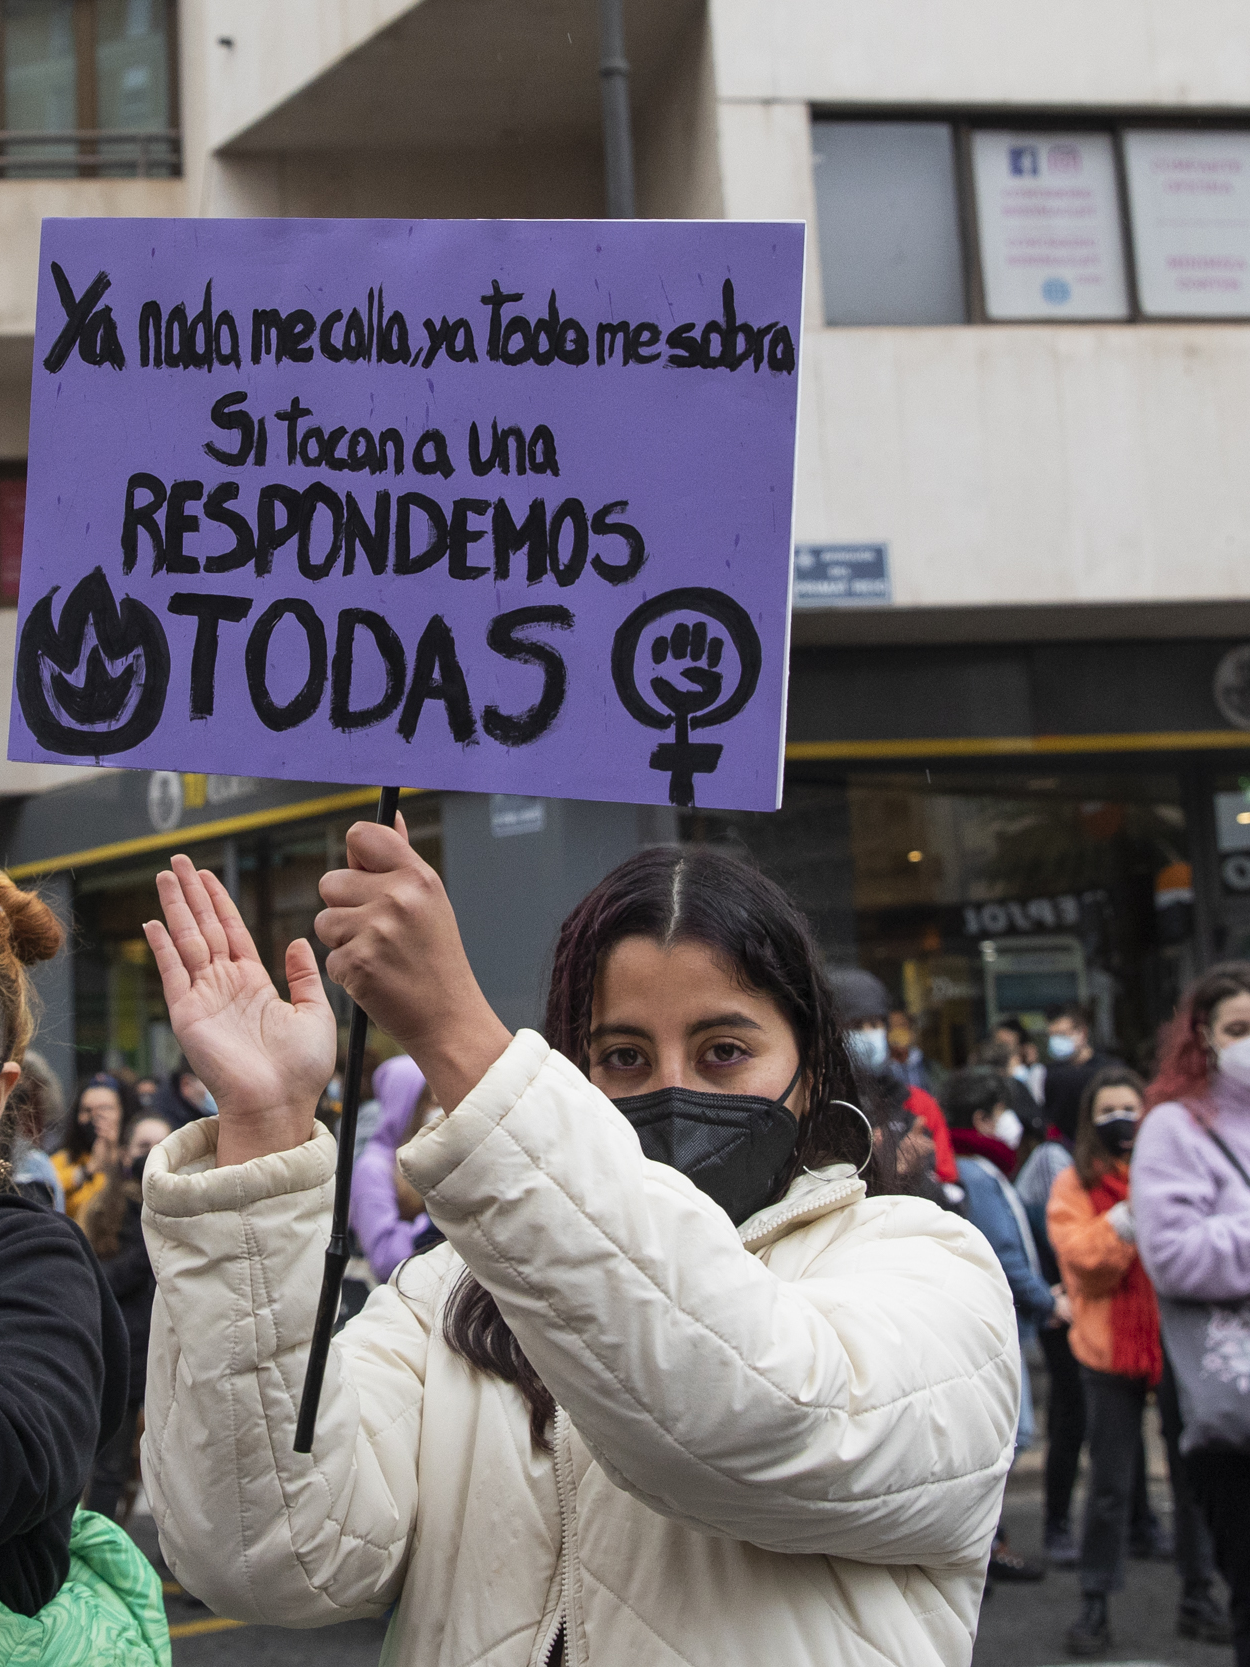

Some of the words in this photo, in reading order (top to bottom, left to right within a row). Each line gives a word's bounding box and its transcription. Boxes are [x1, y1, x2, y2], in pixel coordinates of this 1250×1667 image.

[43, 261, 125, 374] Ya
[139, 279, 241, 373] nada
[251, 309, 316, 365] me
[423, 316, 478, 369] ya
[596, 321, 662, 366] me
[666, 278, 795, 375] sobra
[205, 391, 267, 466] Si
[274, 396, 404, 475] tocan
[412, 429, 455, 480] a
[121, 473, 648, 586] RESPONDEMOS
[168, 592, 575, 747] TODAS
